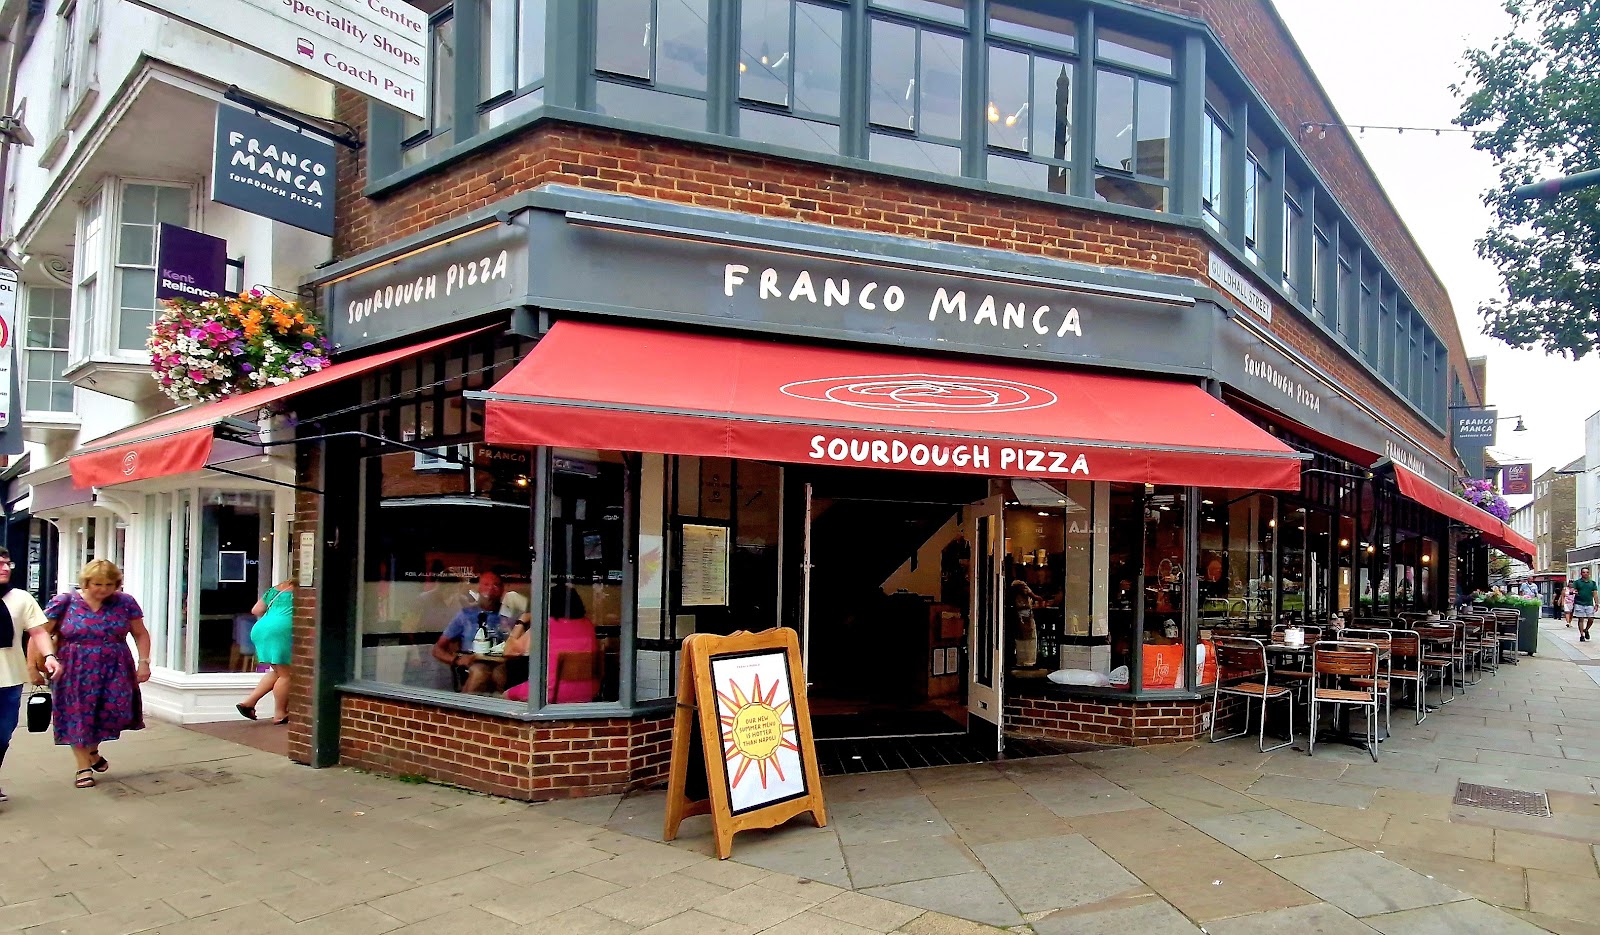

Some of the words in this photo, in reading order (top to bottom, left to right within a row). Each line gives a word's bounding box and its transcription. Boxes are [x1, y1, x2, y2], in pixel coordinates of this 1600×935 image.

[368, 0, 421, 32] Centre
[373, 34, 420, 66] Shops
[324, 52, 377, 86] Coach
[229, 131, 326, 177] FRANCO
[230, 150, 323, 196] MANCA
[229, 172, 286, 197] SOURDOUGH
[290, 192, 322, 209] PIZZA
[162, 278, 219, 298] Reliance
[163, 268, 195, 284] Kent
[348, 274, 437, 325] SOURDOUGH
[446, 249, 508, 297] PIZZA
[1212, 260, 1248, 299] GUILDHALL
[1249, 290, 1269, 316] STREET
[724, 263, 905, 312] FRANCO
[928, 286, 1083, 337] MANCA
[1244, 353, 1294, 399] SOURDOUGH
[1297, 383, 1320, 414] PIZZA
[1460, 418, 1494, 426] FRANCO
[1460, 425, 1493, 433] MANCA
[478, 448, 526, 463] FRANCO
[809, 434, 990, 469] SOURDOUGH
[1000, 446, 1090, 475] PIZZA
[739, 723, 761, 734] SUMMER
[762, 720, 776, 729] MENU
[745, 717, 757, 725] OUR
[757, 715, 769, 723] NEW
[752, 728, 772, 738] HOTTER
[742, 738, 758, 747] THAN
[758, 734, 777, 744] NAPOLI
